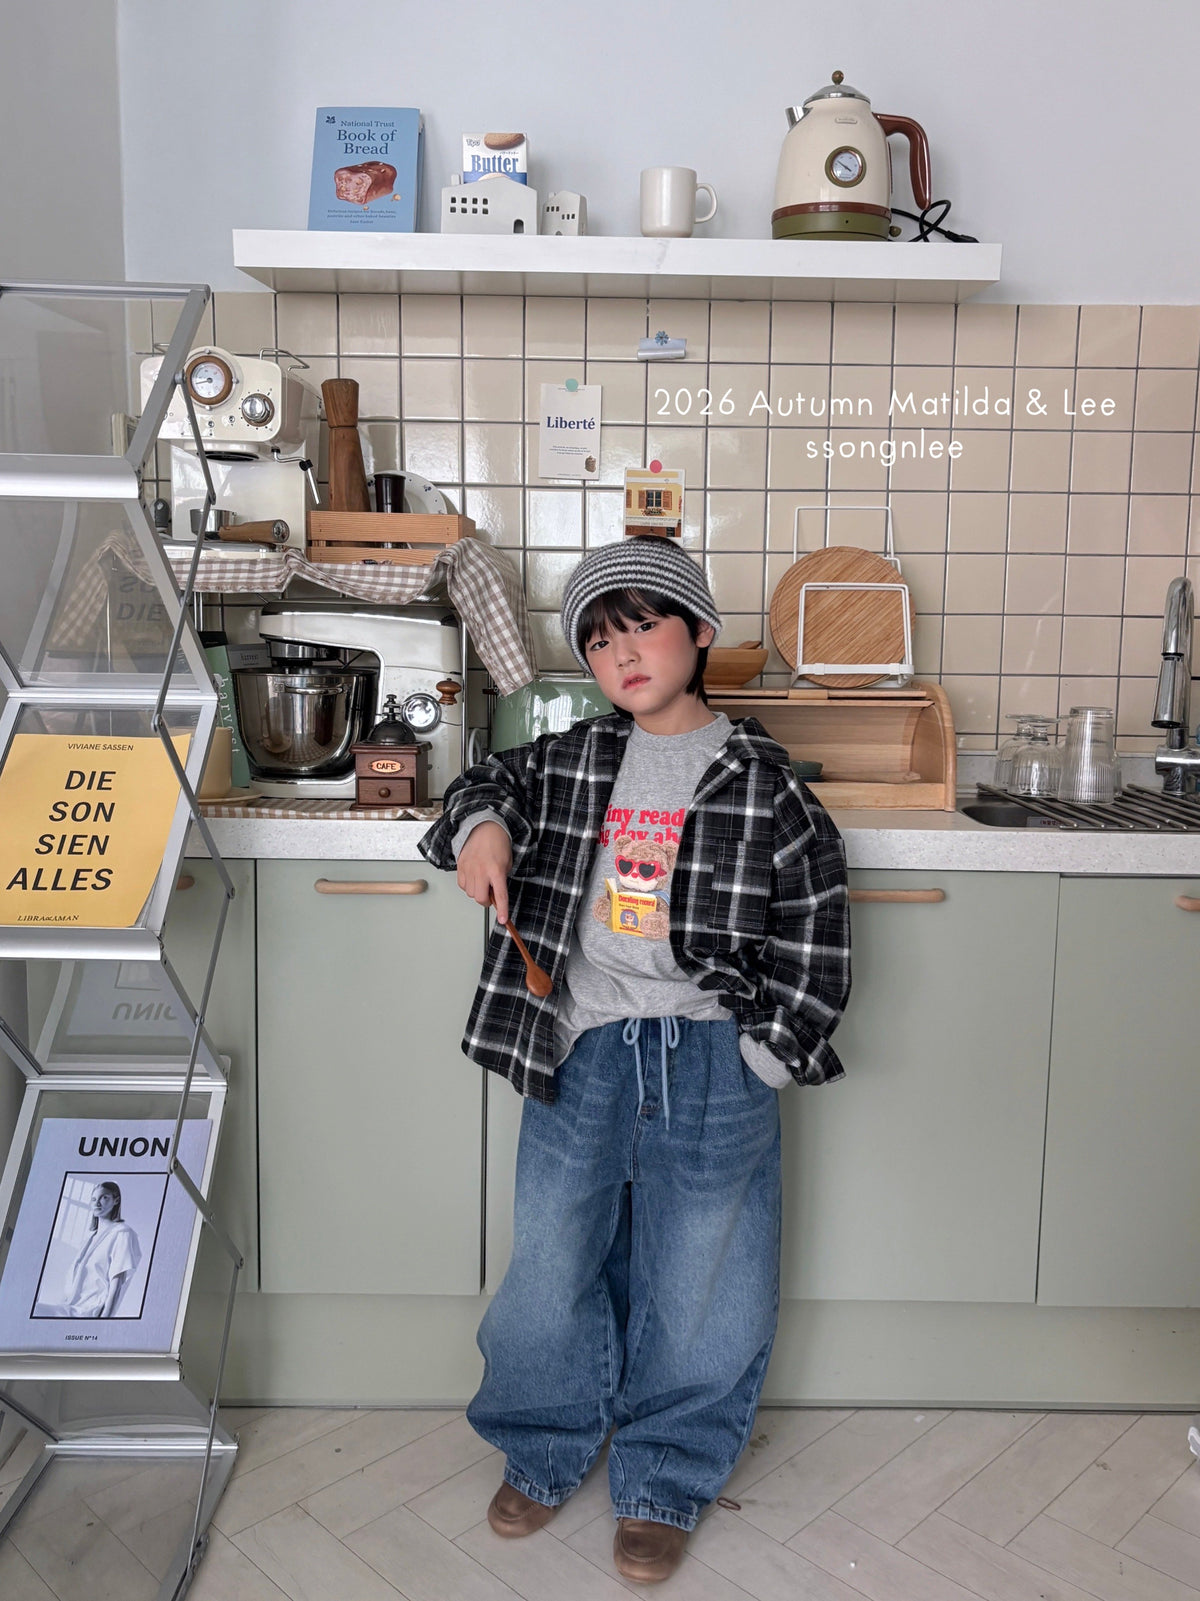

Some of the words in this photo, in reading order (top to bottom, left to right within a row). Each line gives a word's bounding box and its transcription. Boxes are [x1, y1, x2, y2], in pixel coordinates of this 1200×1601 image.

[337, 129, 376, 141] Book
[380, 130, 397, 142] of
[343, 143, 389, 154] Bread
[471, 154, 519, 173] Butter
[547, 416, 596, 430] Liberté
[376, 762, 397, 770] CAFE
[64, 770, 116, 791] DIE
[48, 801, 115, 822] SON
[605, 804, 635, 835] iny
[34, 834, 110, 856] SIEN
[6, 867, 114, 891] ALLES
[78, 1137, 171, 1157] UNION
